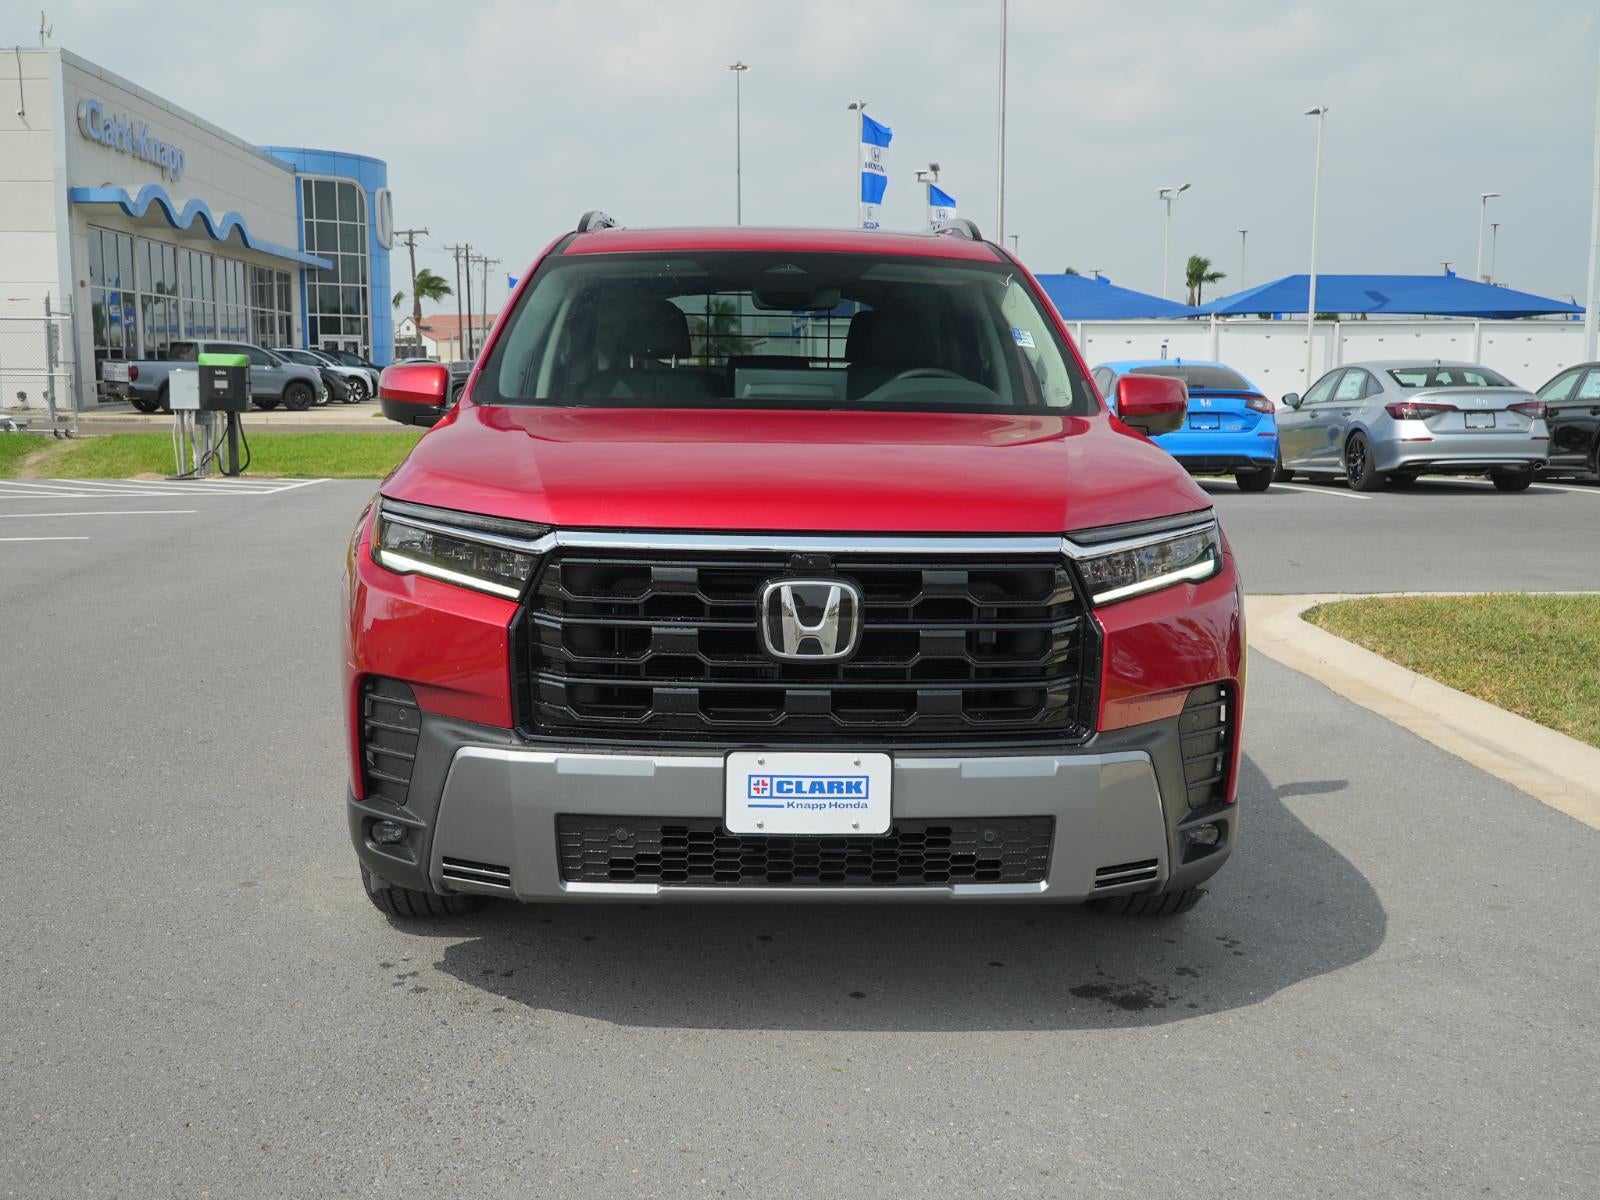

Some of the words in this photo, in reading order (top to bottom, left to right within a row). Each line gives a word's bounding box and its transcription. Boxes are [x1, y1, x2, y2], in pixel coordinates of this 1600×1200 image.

[776, 780, 863, 795] CLARK
[786, 801, 827, 811] Knapp
[828, 801, 869, 810] Honda
